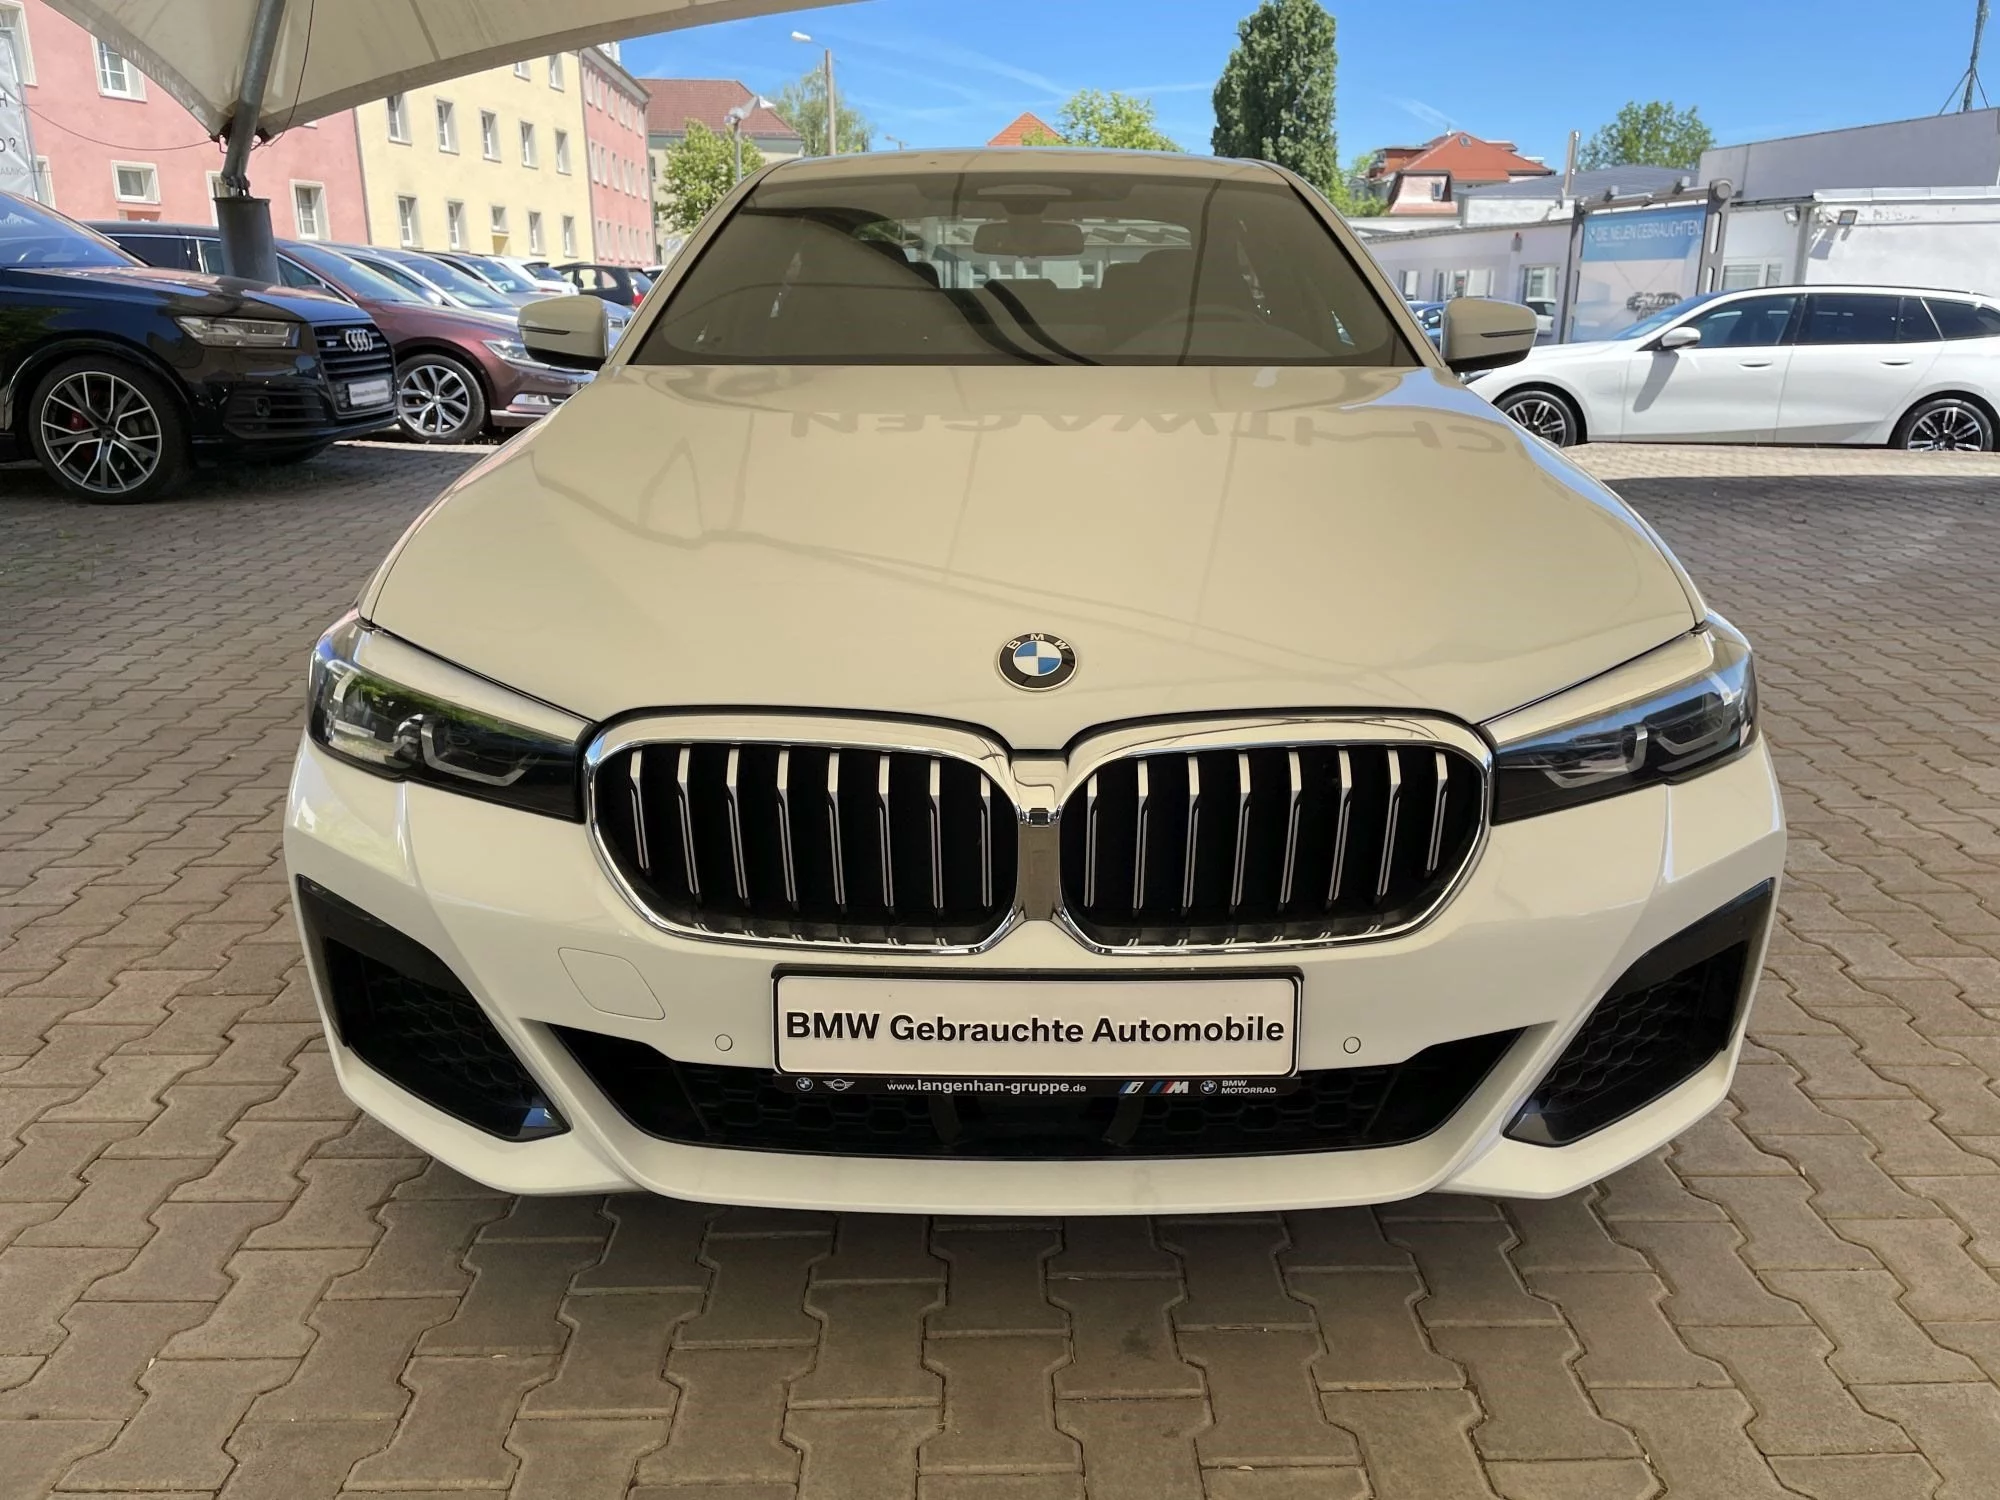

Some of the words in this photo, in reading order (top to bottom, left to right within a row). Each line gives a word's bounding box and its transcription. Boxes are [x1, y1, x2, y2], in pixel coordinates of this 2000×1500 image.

[1006, 633, 1070, 650] BMW
[786, 1011, 880, 1040] BMW
[890, 1014, 1084, 1043] Gebrauchte
[1091, 1015, 1285, 1043] Automobile
[886, 1079, 1087, 1095] www.langenhan-gruppe.de
[1220, 1086, 1277, 1095] MOTORRAD
[1221, 1079, 1248, 1087] BMW
